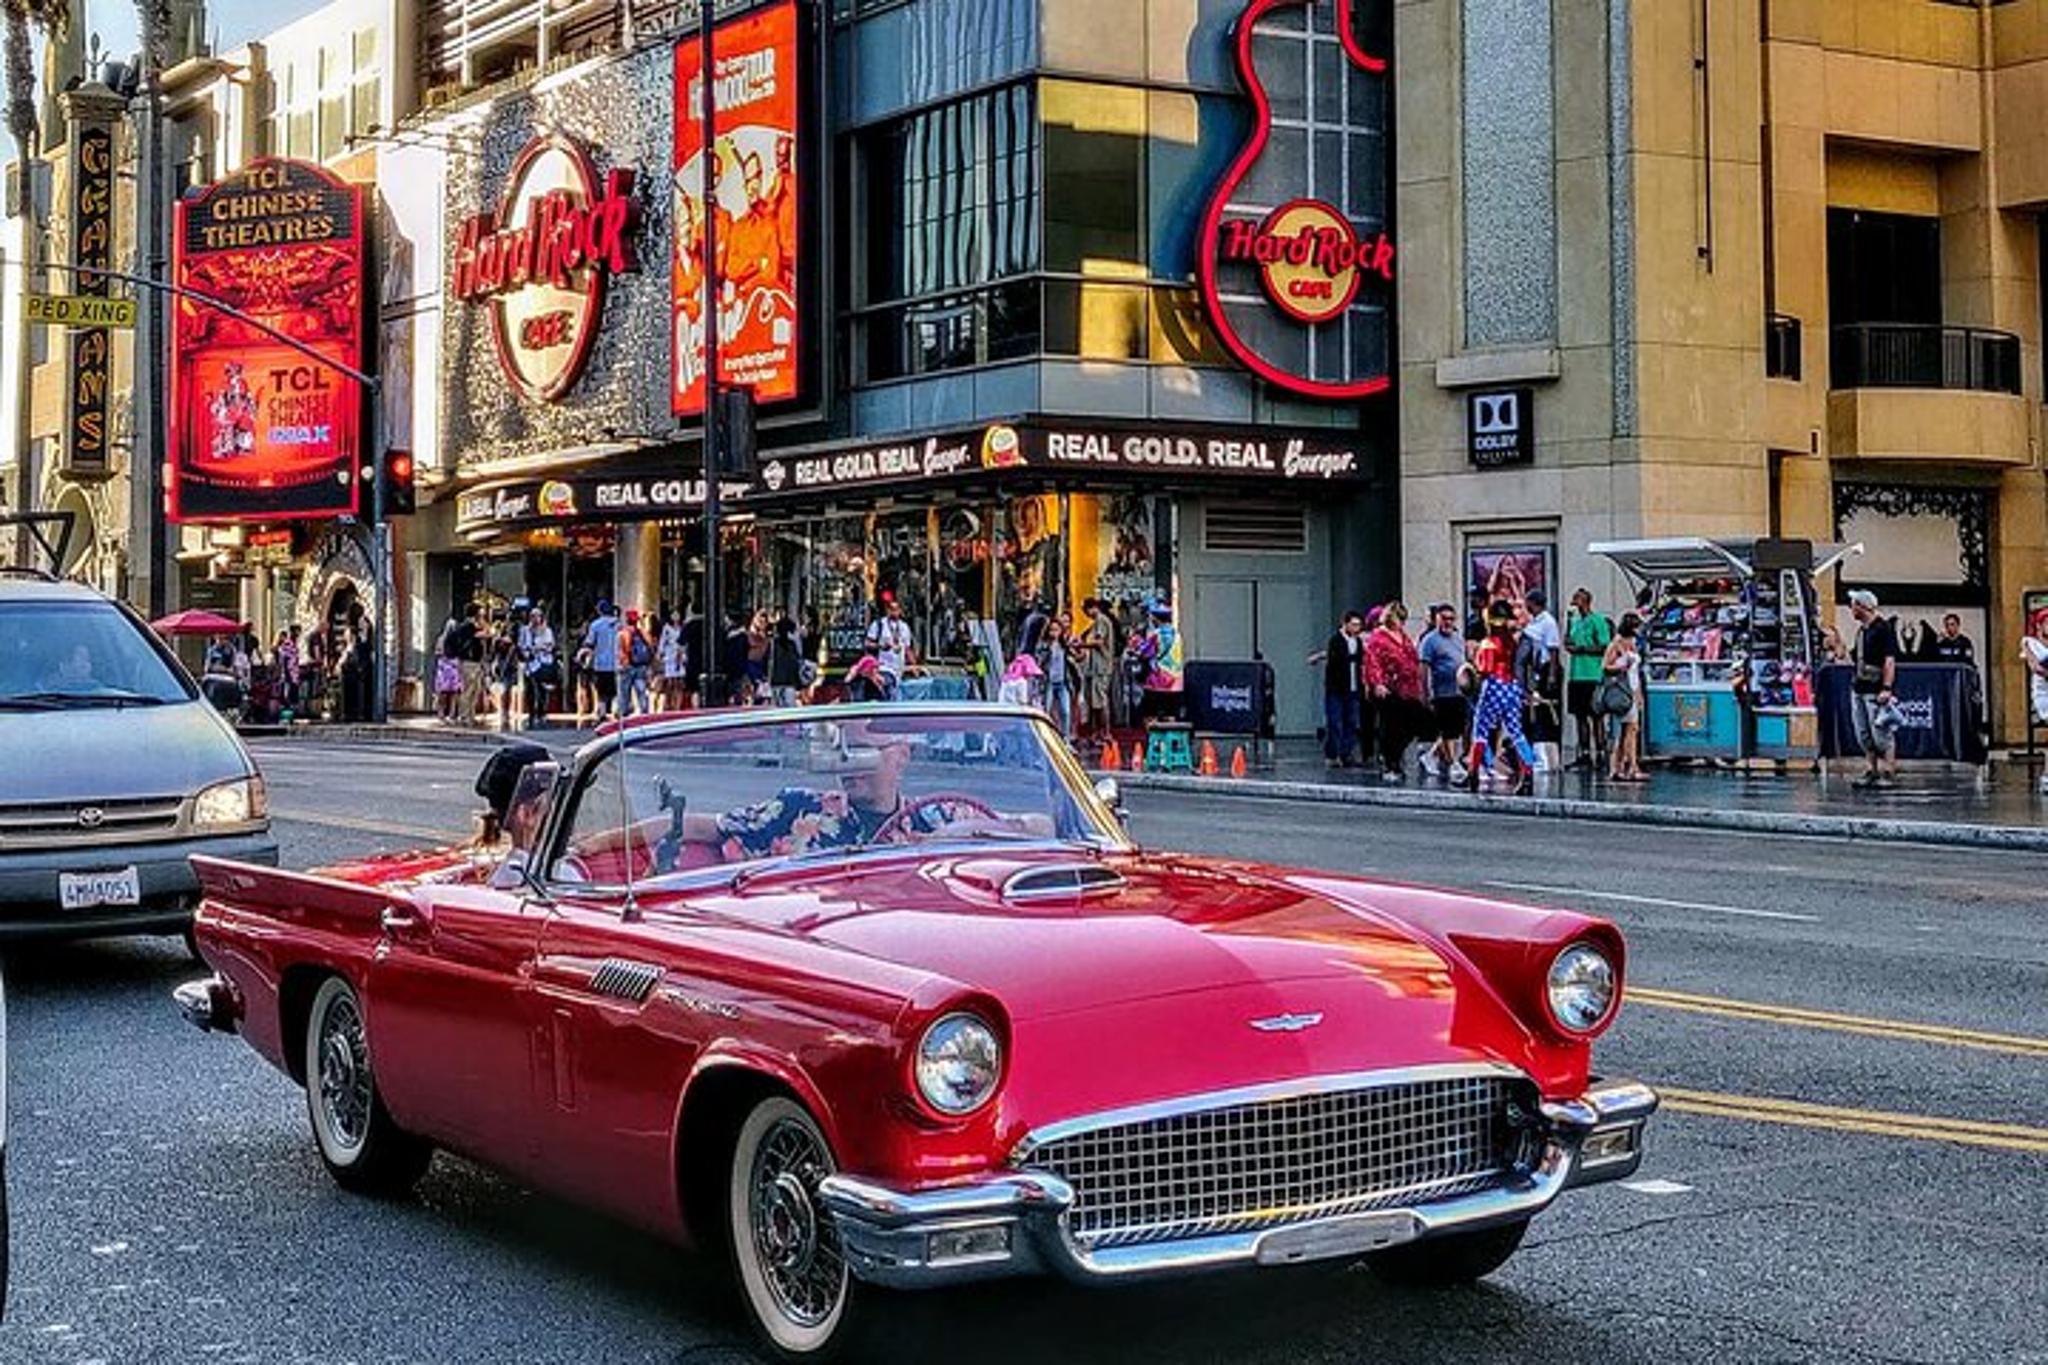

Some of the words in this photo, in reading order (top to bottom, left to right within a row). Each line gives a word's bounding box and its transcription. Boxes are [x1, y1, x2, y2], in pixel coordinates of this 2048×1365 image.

[244, 166, 292, 189] TCL
[213, 190, 323, 221] CHINESE
[202, 215, 333, 248] THEATRES
[454, 194, 536, 300] Hard
[537, 168, 636, 291] Rock
[1227, 219, 1316, 265] Hard
[1315, 227, 1394, 279] Rock
[78, 136, 108, 451] GRAUANS
[28, 298, 70, 320] PED
[79, 301, 129, 323] XING
[269, 366, 331, 394] TCL
[1048, 433, 1119, 462] REAL
[1122, 436, 1202, 465] GOLD.
[1207, 440, 1275, 469] REAL
[1475, 434, 1518, 450] DOLBY
[795, 458, 833, 485] REAL
[833, 451, 877, 481] GOLD.
[878, 446, 920, 475] REAL
[595, 484, 648, 507] REAL
